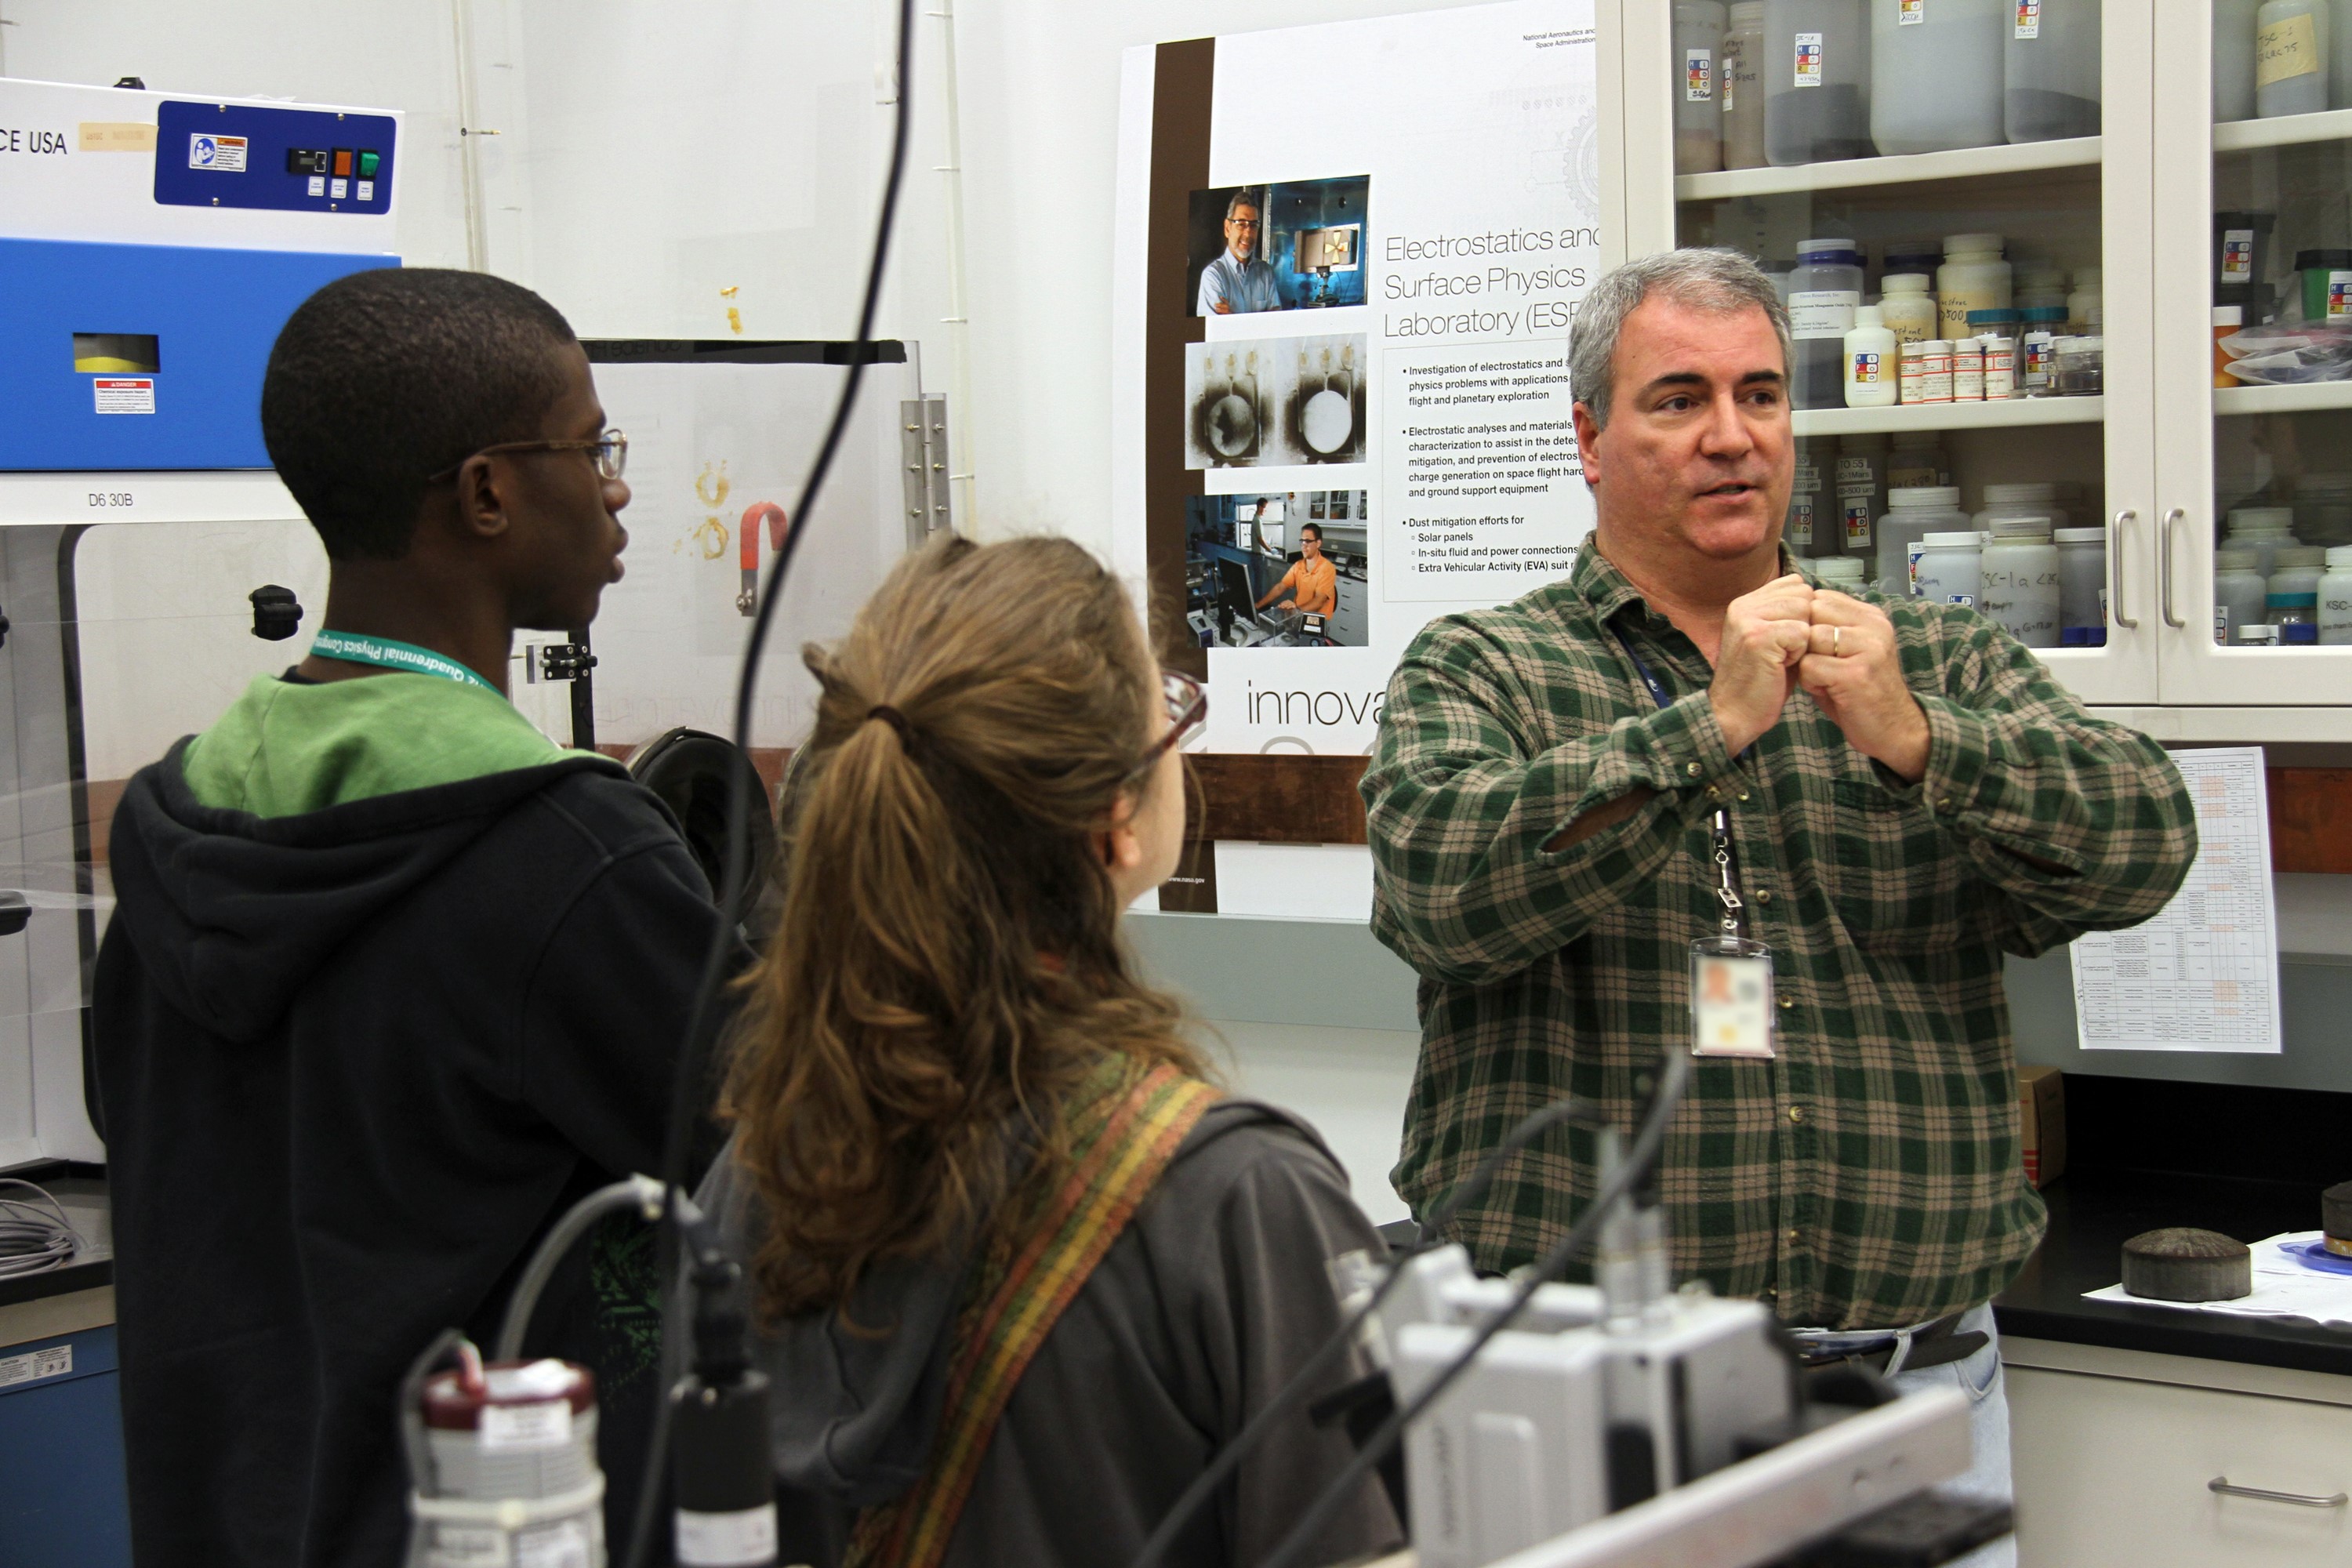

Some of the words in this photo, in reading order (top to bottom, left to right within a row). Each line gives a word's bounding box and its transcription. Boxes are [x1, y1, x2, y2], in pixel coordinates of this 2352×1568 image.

[1548, 29, 1584, 38] Aeronautics
[1555, 37, 1595, 46] Administration
[30, 131, 67, 154] USA
[1385, 227, 1554, 261] Electrostatics
[1385, 272, 1482, 299] Surface
[1488, 264, 1585, 296] Physics
[1385, 309, 1519, 337] Laboratory
[1409, 363, 1466, 376] Investigation
[1468, 363, 1478, 372] of
[1480, 359, 1543, 372] electrostatics
[1545, 358, 1563, 368] and
[1409, 381, 1443, 392] physics
[1445, 378, 1487, 390] problems
[1490, 376, 1509, 387] with
[1512, 374, 1569, 388] applications
[1409, 397, 1432, 407] flight
[1434, 395, 1450, 405] and
[1453, 394, 1495, 405] planetary
[1497, 390, 1549, 402] exploration
[1409, 426, 1465, 436] Electrostatic
[1467, 424, 1507, 435] analyses
[1509, 422, 1526, 431] and
[1529, 420, 1573, 430] materials
[1408, 440, 1481, 451] characterization
[1495, 437, 1522, 448] assist
[1525, 437, 1533, 446] in
[1536, 437, 1551, 445] the
[1409, 456, 1456, 467] mitigation,
[1458, 456, 1475, 465] and
[1477, 453, 1526, 466] prevention
[1528, 452, 1538, 461] of
[1853, 459, 1864, 468] 55
[1409, 472, 1439, 482] charge
[1442, 470, 1490, 482] generation
[1493, 470, 1504, 479] on
[1507, 470, 1534, 480] space
[1537, 467, 1560, 478] flight
[1408, 488, 1425, 497] and
[1428, 486, 1459, 499] ground
[1461, 485, 1497, 496] support
[1499, 484, 1548, 496] equipment
[89, 493, 107, 506] D6
[109, 493, 133, 506] 30B
[1409, 518, 1429, 528] Dust
[1432, 517, 1476, 528] mitigation
[1479, 515, 1509, 525] efforts
[1512, 515, 1524, 524] for
[1417, 533, 1441, 542] Solar
[1443, 532, 1473, 543] panels
[1418, 549, 1446, 557] In-situ
[1449, 547, 1468, 557] fluid
[1471, 547, 1488, 556] and
[1490, 546, 1519, 557] power
[1522, 545, 1578, 555] connections
[1418, 564, 1442, 572] Extra
[1444, 562, 1485, 572] Vehicular
[1487, 561, 1522, 572] Activity
[1524, 561, 1548, 572] (EVA)
[1551, 561, 1569, 570] suit
[343, 640, 382, 660] Physics
[383, 647, 465, 682] Quadrennial
